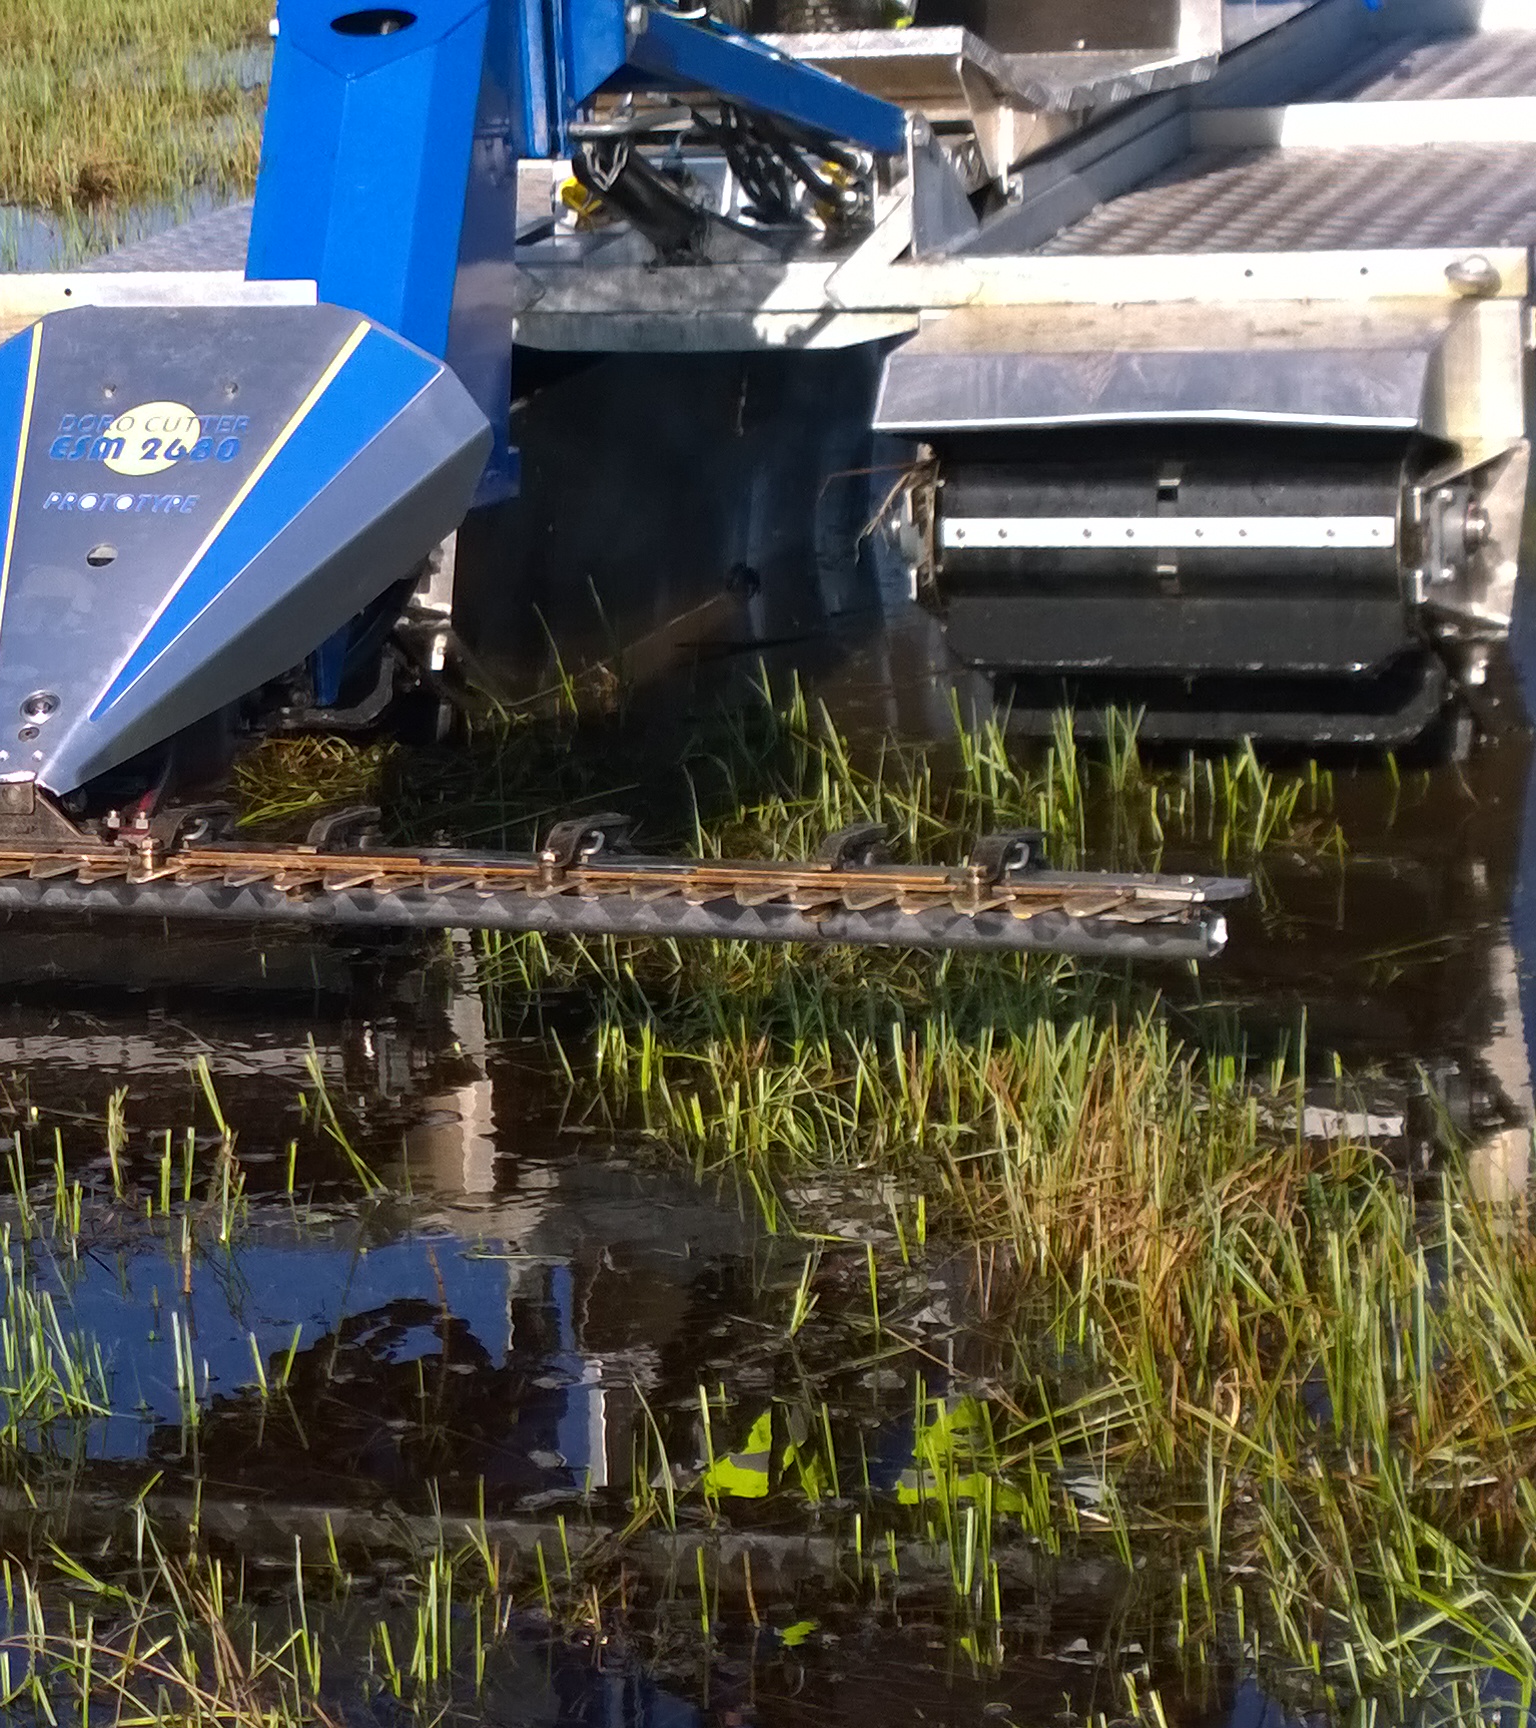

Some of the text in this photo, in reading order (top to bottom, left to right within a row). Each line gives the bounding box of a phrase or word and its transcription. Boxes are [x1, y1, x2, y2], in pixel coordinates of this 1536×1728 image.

[59, 414, 250, 433] DORO CUTTER
[49, 435, 240, 462] ESM 2680
[43, 491, 200, 514] PROTOTYPE
